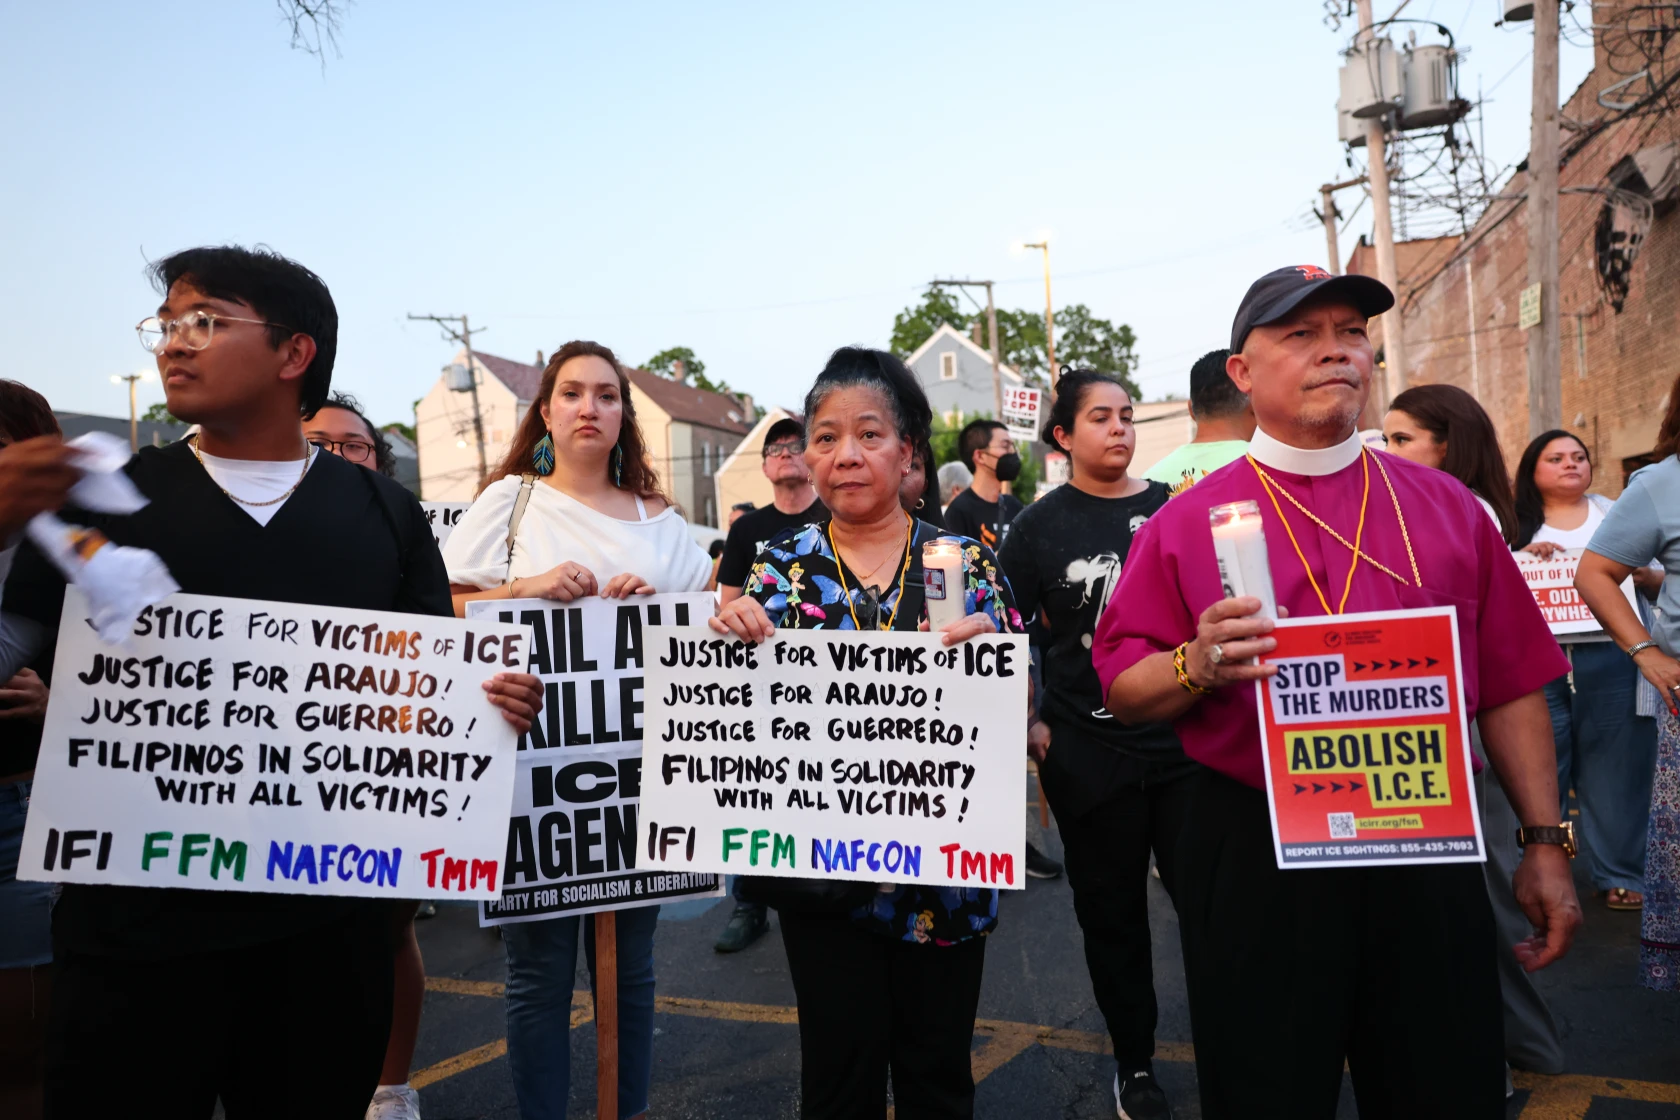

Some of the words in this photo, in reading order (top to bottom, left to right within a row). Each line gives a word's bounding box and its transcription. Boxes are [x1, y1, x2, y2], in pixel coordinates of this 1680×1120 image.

[443, 507, 469, 528] IC
[1523, 570, 1543, 581] OUT
[1548, 569, 1562, 580] OF
[1549, 589, 1580, 605] OUT
[1541, 606, 1595, 622] YWHE
[84, 604, 224, 640] STICE
[248, 611, 299, 646] FOR
[311, 619, 422, 661] VICTIMS
[433, 638, 456, 657] OF
[463, 630, 524, 668] ICE
[499, 608, 598, 675] AIL
[660, 636, 759, 670] JUSTICE
[774, 640, 818, 667] FOR
[827, 641, 928, 675] VICTIMS
[933, 647, 959, 669] OF
[964, 641, 1016, 678] ICE
[78, 653, 214, 691] JUSTICE
[232, 660, 289, 694] FOR
[1275, 660, 1341, 690] STOP
[663, 681, 753, 707] JUSTICE
[770, 681, 813, 706] FOR
[1279, 691, 1322, 716] THE
[1329, 684, 1445, 714] MURDERS
[81, 697, 210, 731] JUSTICE
[223, 699, 279, 730] FOR
[661, 718, 756, 743] JUSTICE
[771, 716, 812, 741] FOR
[68, 738, 244, 776] FILIPINOS
[259, 743, 291, 775] IN
[302, 741, 493, 783] SOLIDARITY
[1291, 729, 1443, 772] ABOLISH
[662, 753, 790, 786] FILIPINOS
[798, 759, 823, 782] IN
[830, 758, 976, 791] SOLIDARITY
[1371, 770, 1447, 802] I.C.E.
[154, 776, 236, 806] WITH
[248, 780, 303, 807] ALL
[713, 788, 773, 811] WITH
[786, 788, 830, 811] ALL
[1359, 816, 1419, 830] icirr.org/fsn
[43, 827, 113, 872] IFI
[141, 831, 248, 882] FFM
[266, 840, 402, 888] NAFCON
[420, 848, 498, 893] TMM
[647, 821, 696, 862] IFI
[722, 827, 796, 869] FFM
[811, 837, 922, 878] NAFCON
[939, 842, 1015, 886] TMM
[1285, 847, 1323, 857] REPORT
[1325, 846, 1342, 856] ICE
[1343, 844, 1400, 855] SIGHTINGS:
[1400, 840, 1474, 854] 855-435-7693
[488, 893, 530, 913] PARTY
[534, 890, 558, 909] FOR
[561, 879, 631, 904] SOCIALISM
[634, 882, 644, 895] &
[647, 872, 715, 894] LIBERATION
